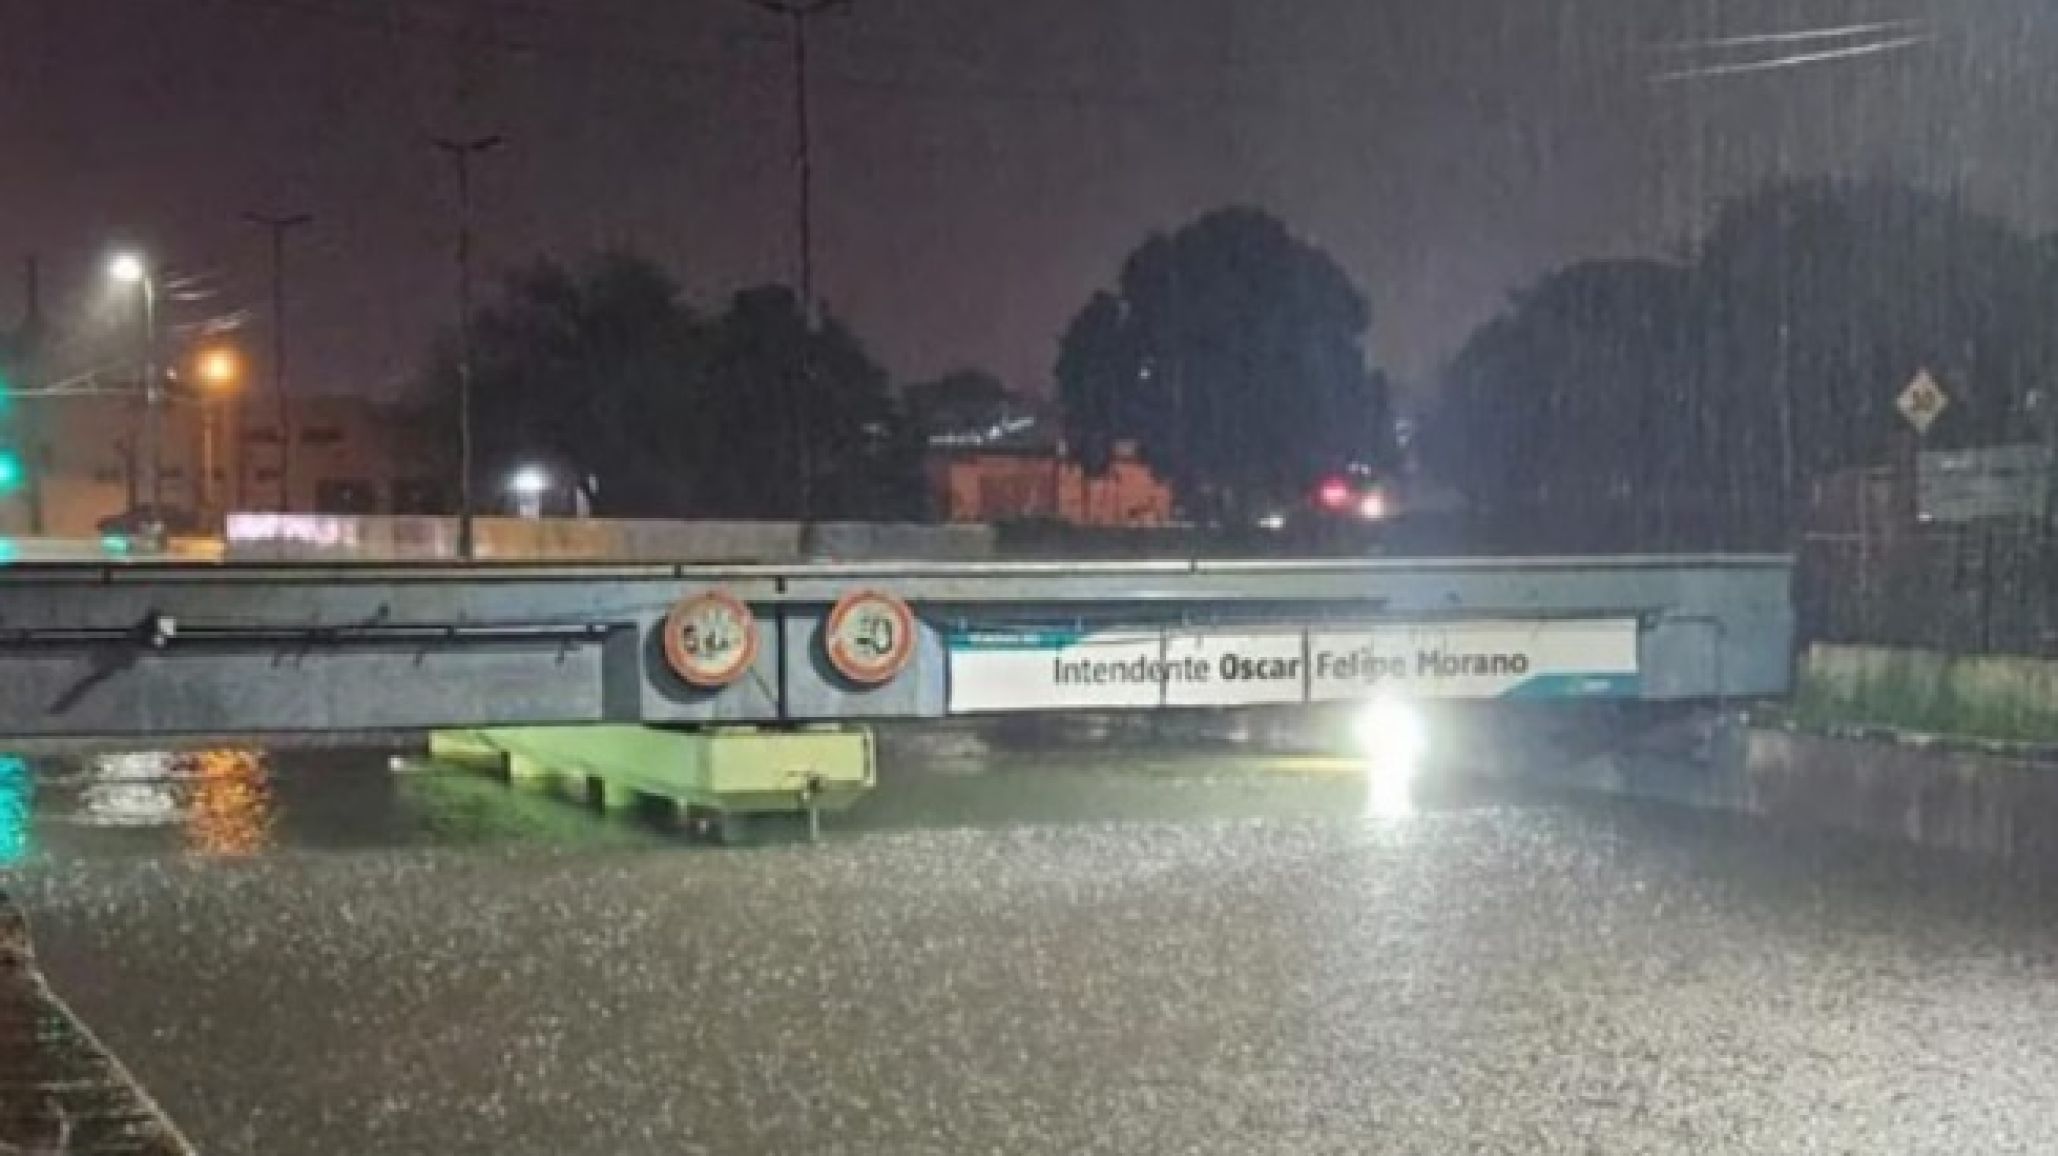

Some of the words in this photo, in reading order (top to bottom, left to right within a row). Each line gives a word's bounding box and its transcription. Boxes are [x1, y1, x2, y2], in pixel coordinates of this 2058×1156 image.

[1053, 653, 1210, 683] Intendente
[1219, 652, 1299, 680] Oscar
[1316, 651, 1405, 682] Felipe
[1418, 650, 1529, 677] Morano
